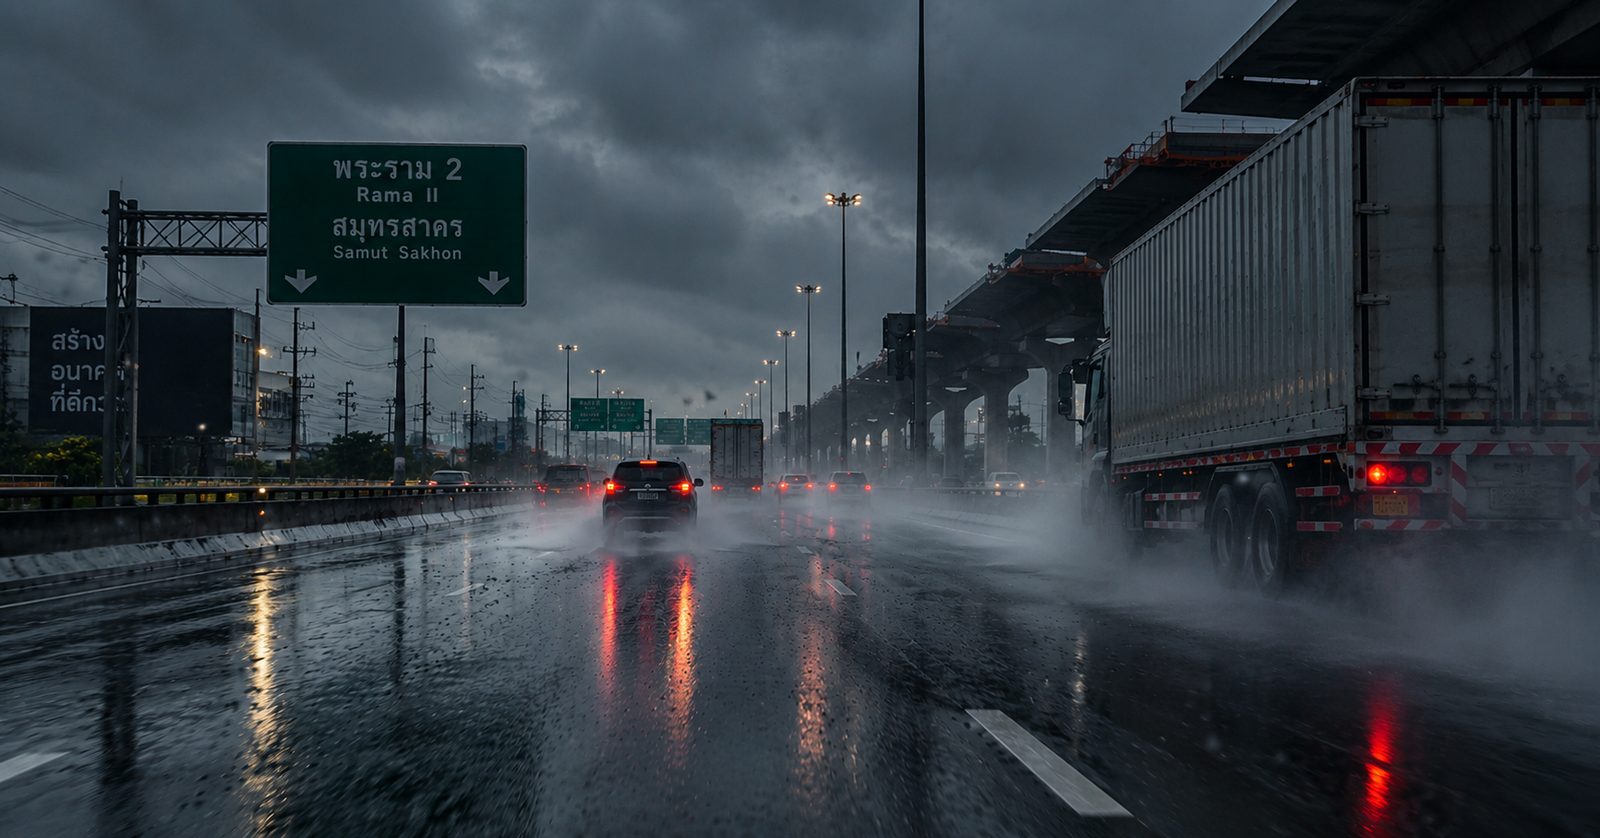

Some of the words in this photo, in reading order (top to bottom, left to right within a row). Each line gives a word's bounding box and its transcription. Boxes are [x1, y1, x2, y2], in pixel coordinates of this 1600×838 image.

[333, 159, 432, 180] พระราม
[446, 157, 463, 181] 2
[357, 187, 413, 203] Rama
[426, 187, 438, 203] II
[333, 217, 463, 243] สมุทรสาคร
[333, 245, 389, 260] Samut
[399, 245, 462, 260] Sakhon
[52, 327, 105, 350] สร้าง
